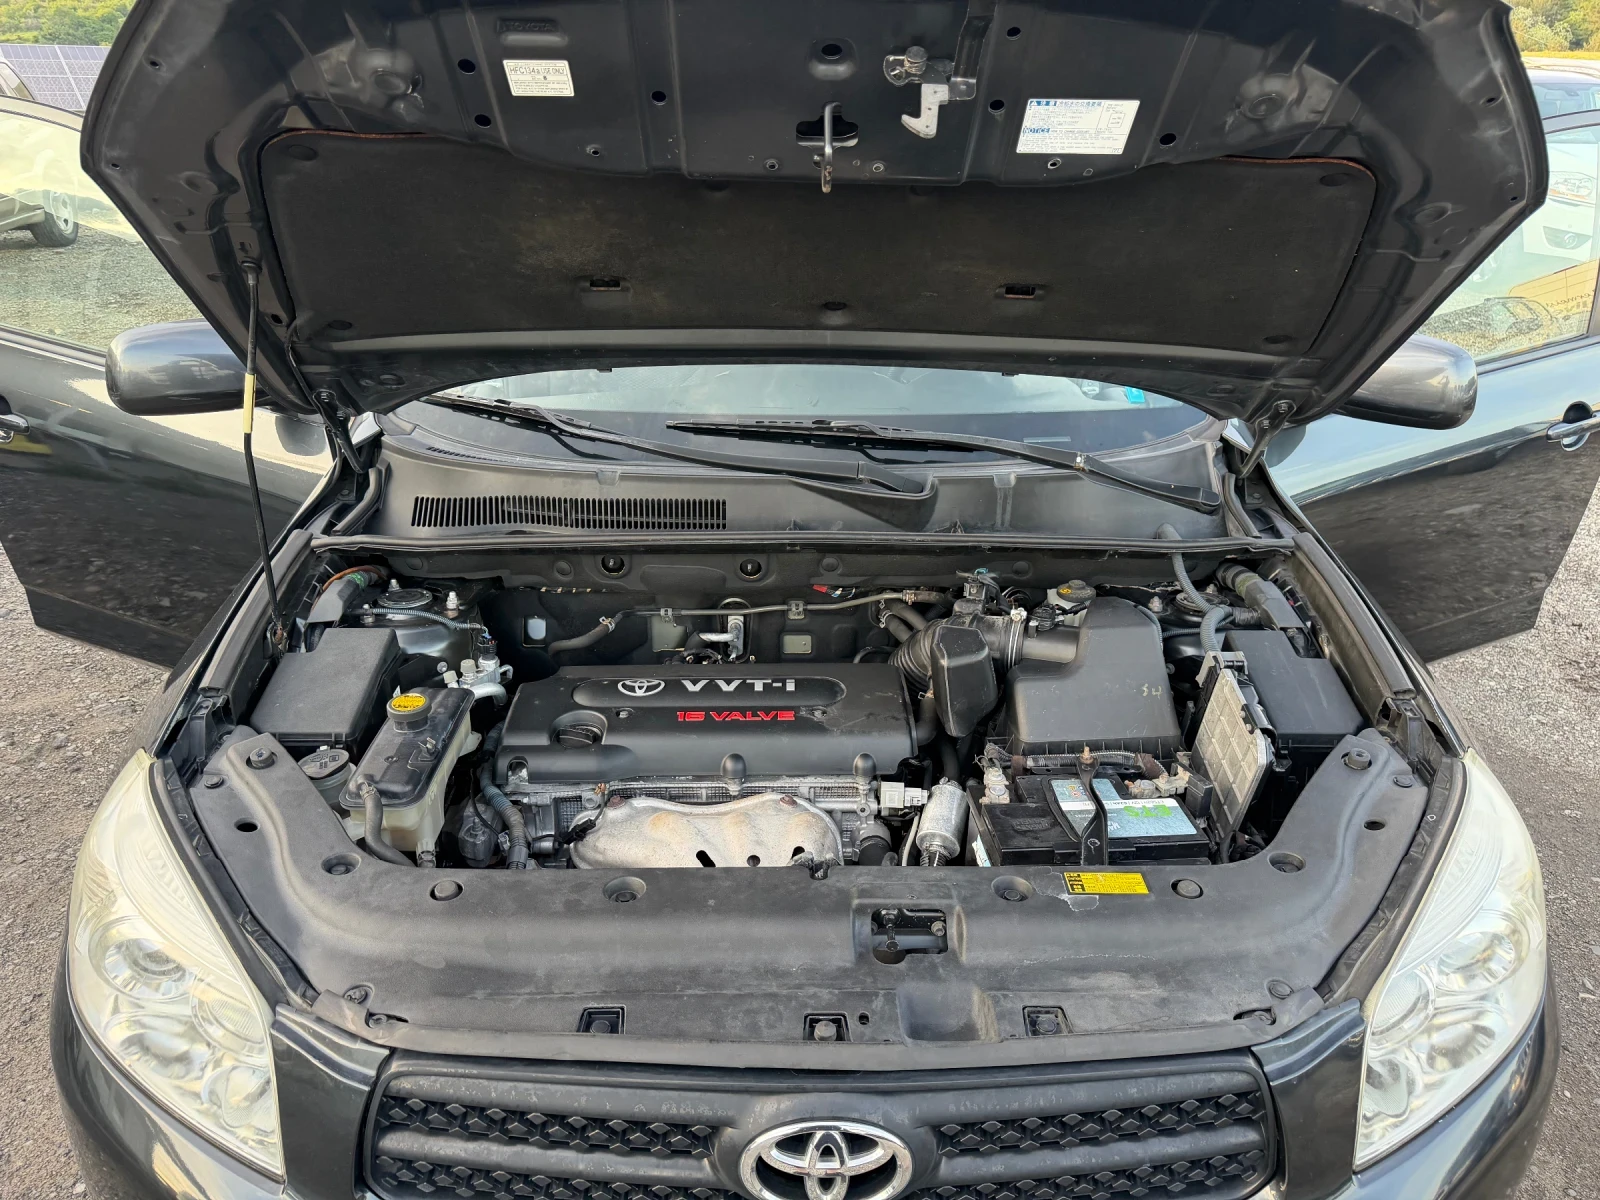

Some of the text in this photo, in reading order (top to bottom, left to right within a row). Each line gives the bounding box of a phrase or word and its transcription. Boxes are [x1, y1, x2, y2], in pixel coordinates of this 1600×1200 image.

[509, 66, 565, 75] HFC134a USE ONLY
[1023, 127, 1051, 135] NOTICE
[676, 711, 796, 721] 16 VALVE
